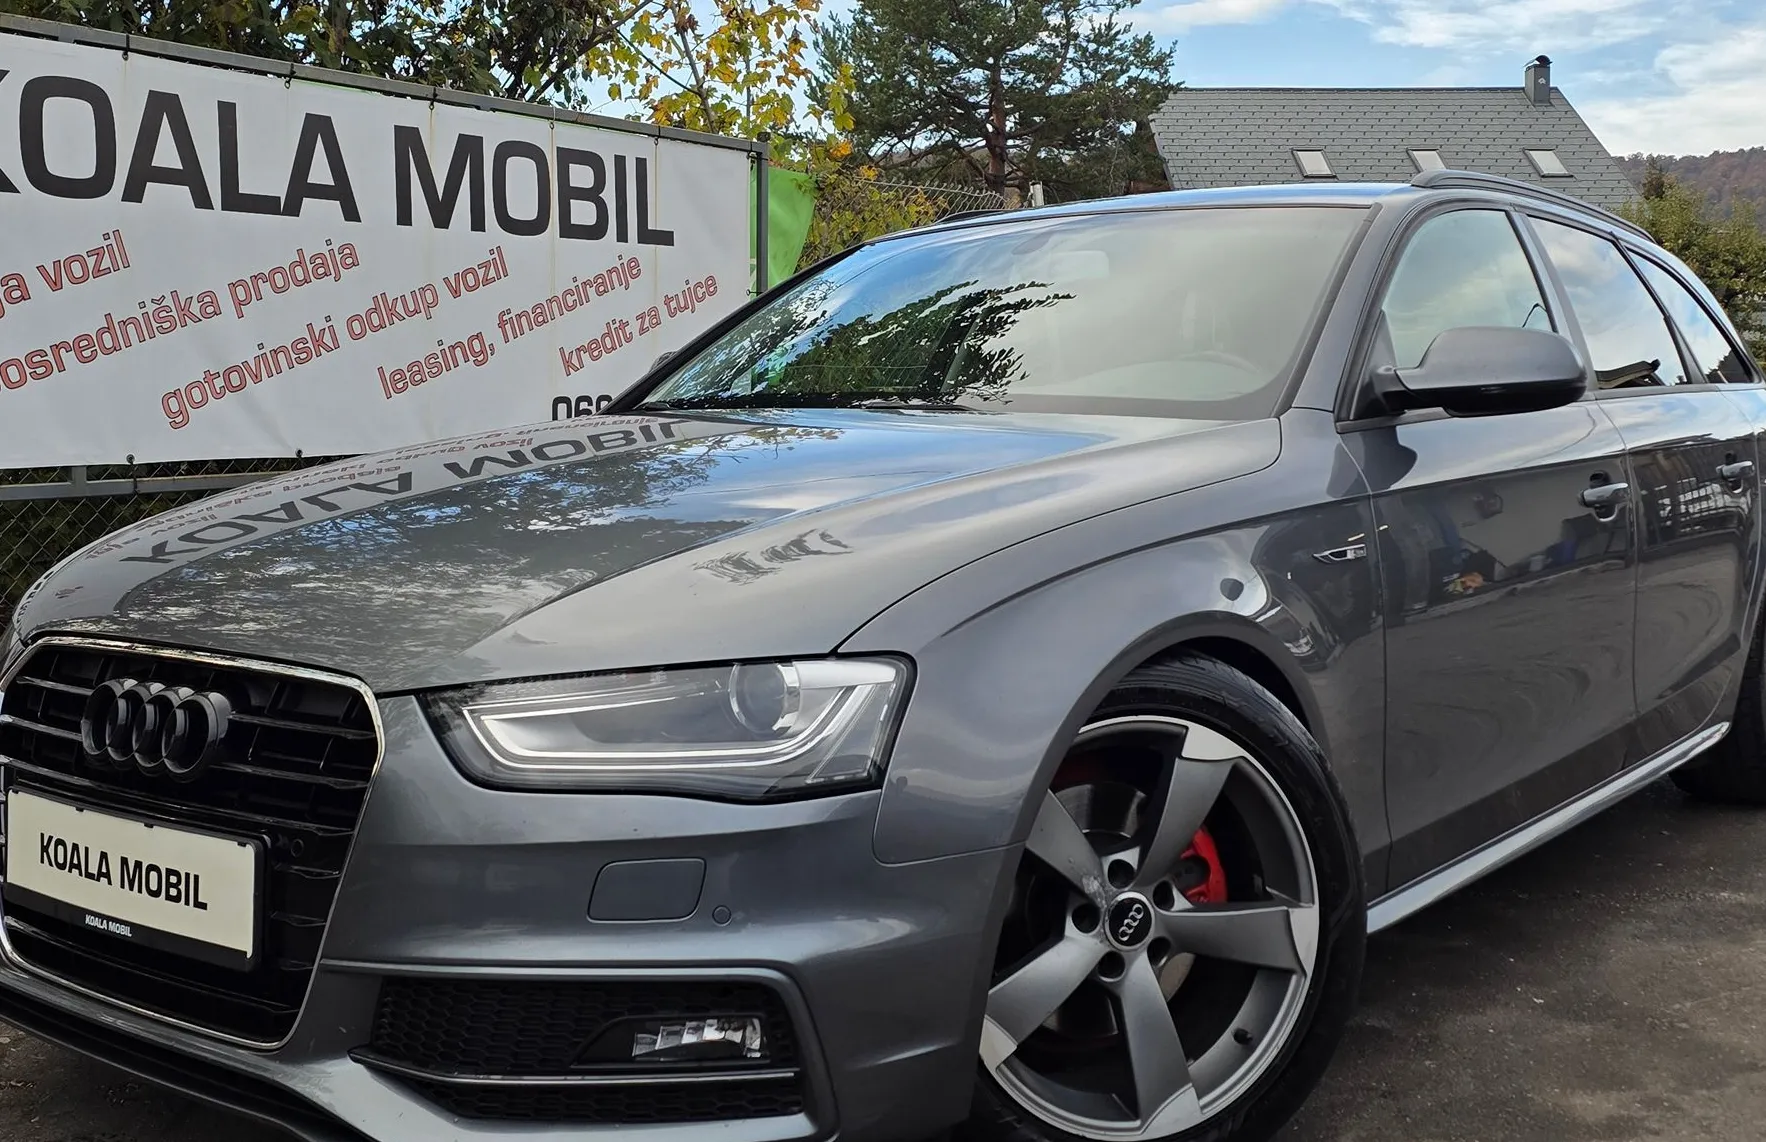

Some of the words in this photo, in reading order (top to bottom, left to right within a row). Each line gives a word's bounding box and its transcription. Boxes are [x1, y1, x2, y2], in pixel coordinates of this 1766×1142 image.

[0, 69, 362, 223] OALA
[394, 124, 674, 247] MOBIL
[0, 290, 222, 391] osredniška
[228, 239, 360, 319] prodaja
[36, 229, 131, 292] vozil
[161, 315, 340, 429] gotovinski
[346, 282, 438, 341] odkup
[443, 246, 509, 299] vozil
[377, 332, 495, 399] leasing,
[498, 255, 642, 343] financiranje
[559, 319, 633, 376] kredit
[636, 304, 662, 336] za
[664, 275, 718, 320] tujce
[40, 832, 112, 886] KOALA
[120, 855, 207, 911] MOBIL
[85, 914, 107, 930] KOALA
[108, 921, 132, 937] MOBIL
